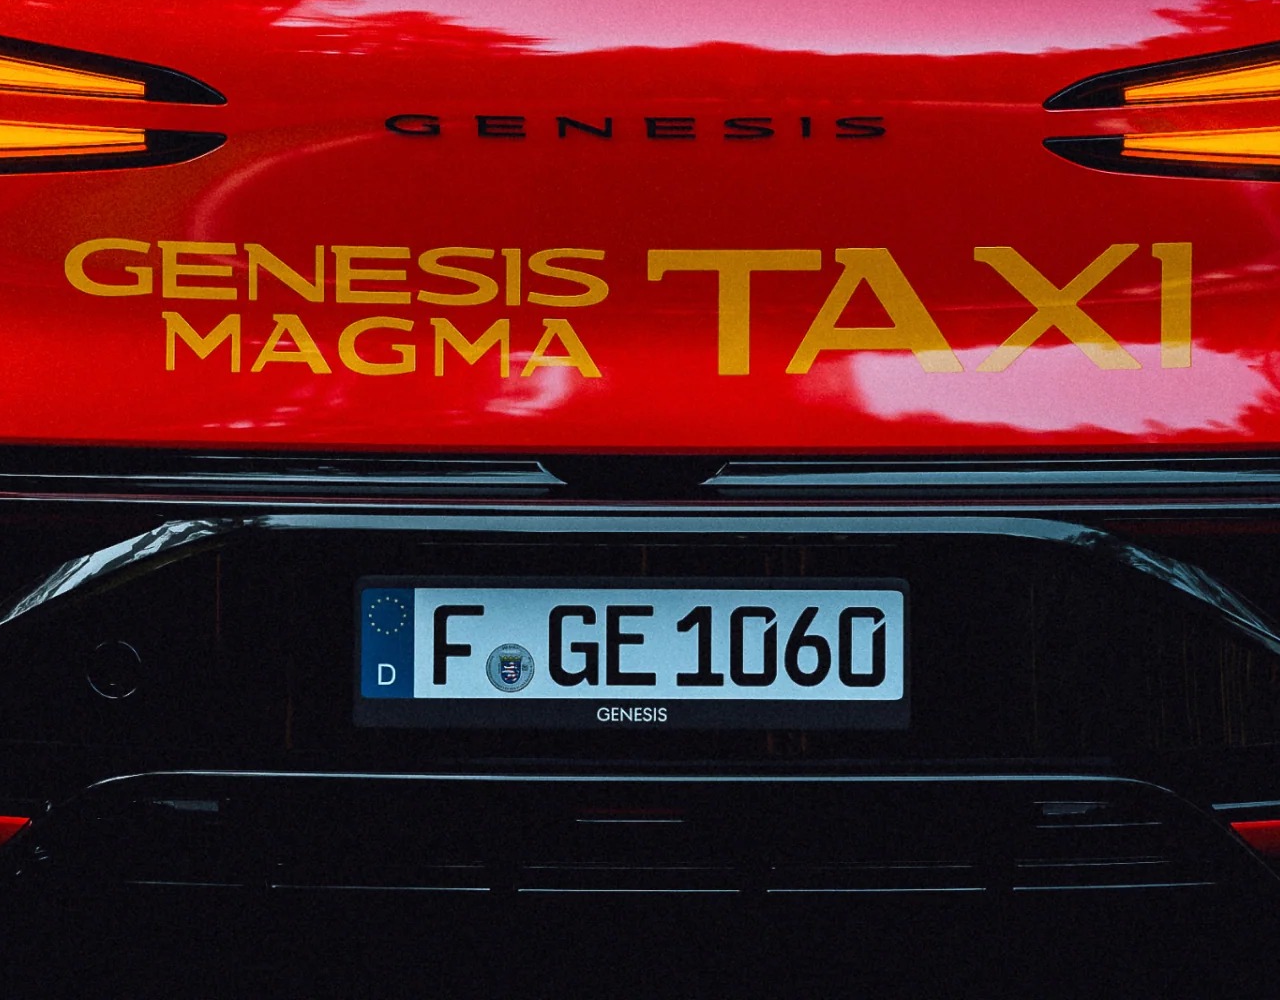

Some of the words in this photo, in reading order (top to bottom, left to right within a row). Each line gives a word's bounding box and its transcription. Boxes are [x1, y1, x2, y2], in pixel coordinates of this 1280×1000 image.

[384, 113, 887, 140] GENESIS
[64, 237, 610, 308] GENESIS
[646, 241, 1194, 378] TAXI
[160, 310, 603, 378] MAGMA
[377, 663, 397, 687] D
[432, 604, 485, 686] F
[548, 604, 657, 687] GE
[675, 605, 887, 687] 1060
[596, 706, 668, 723] GENESIS
